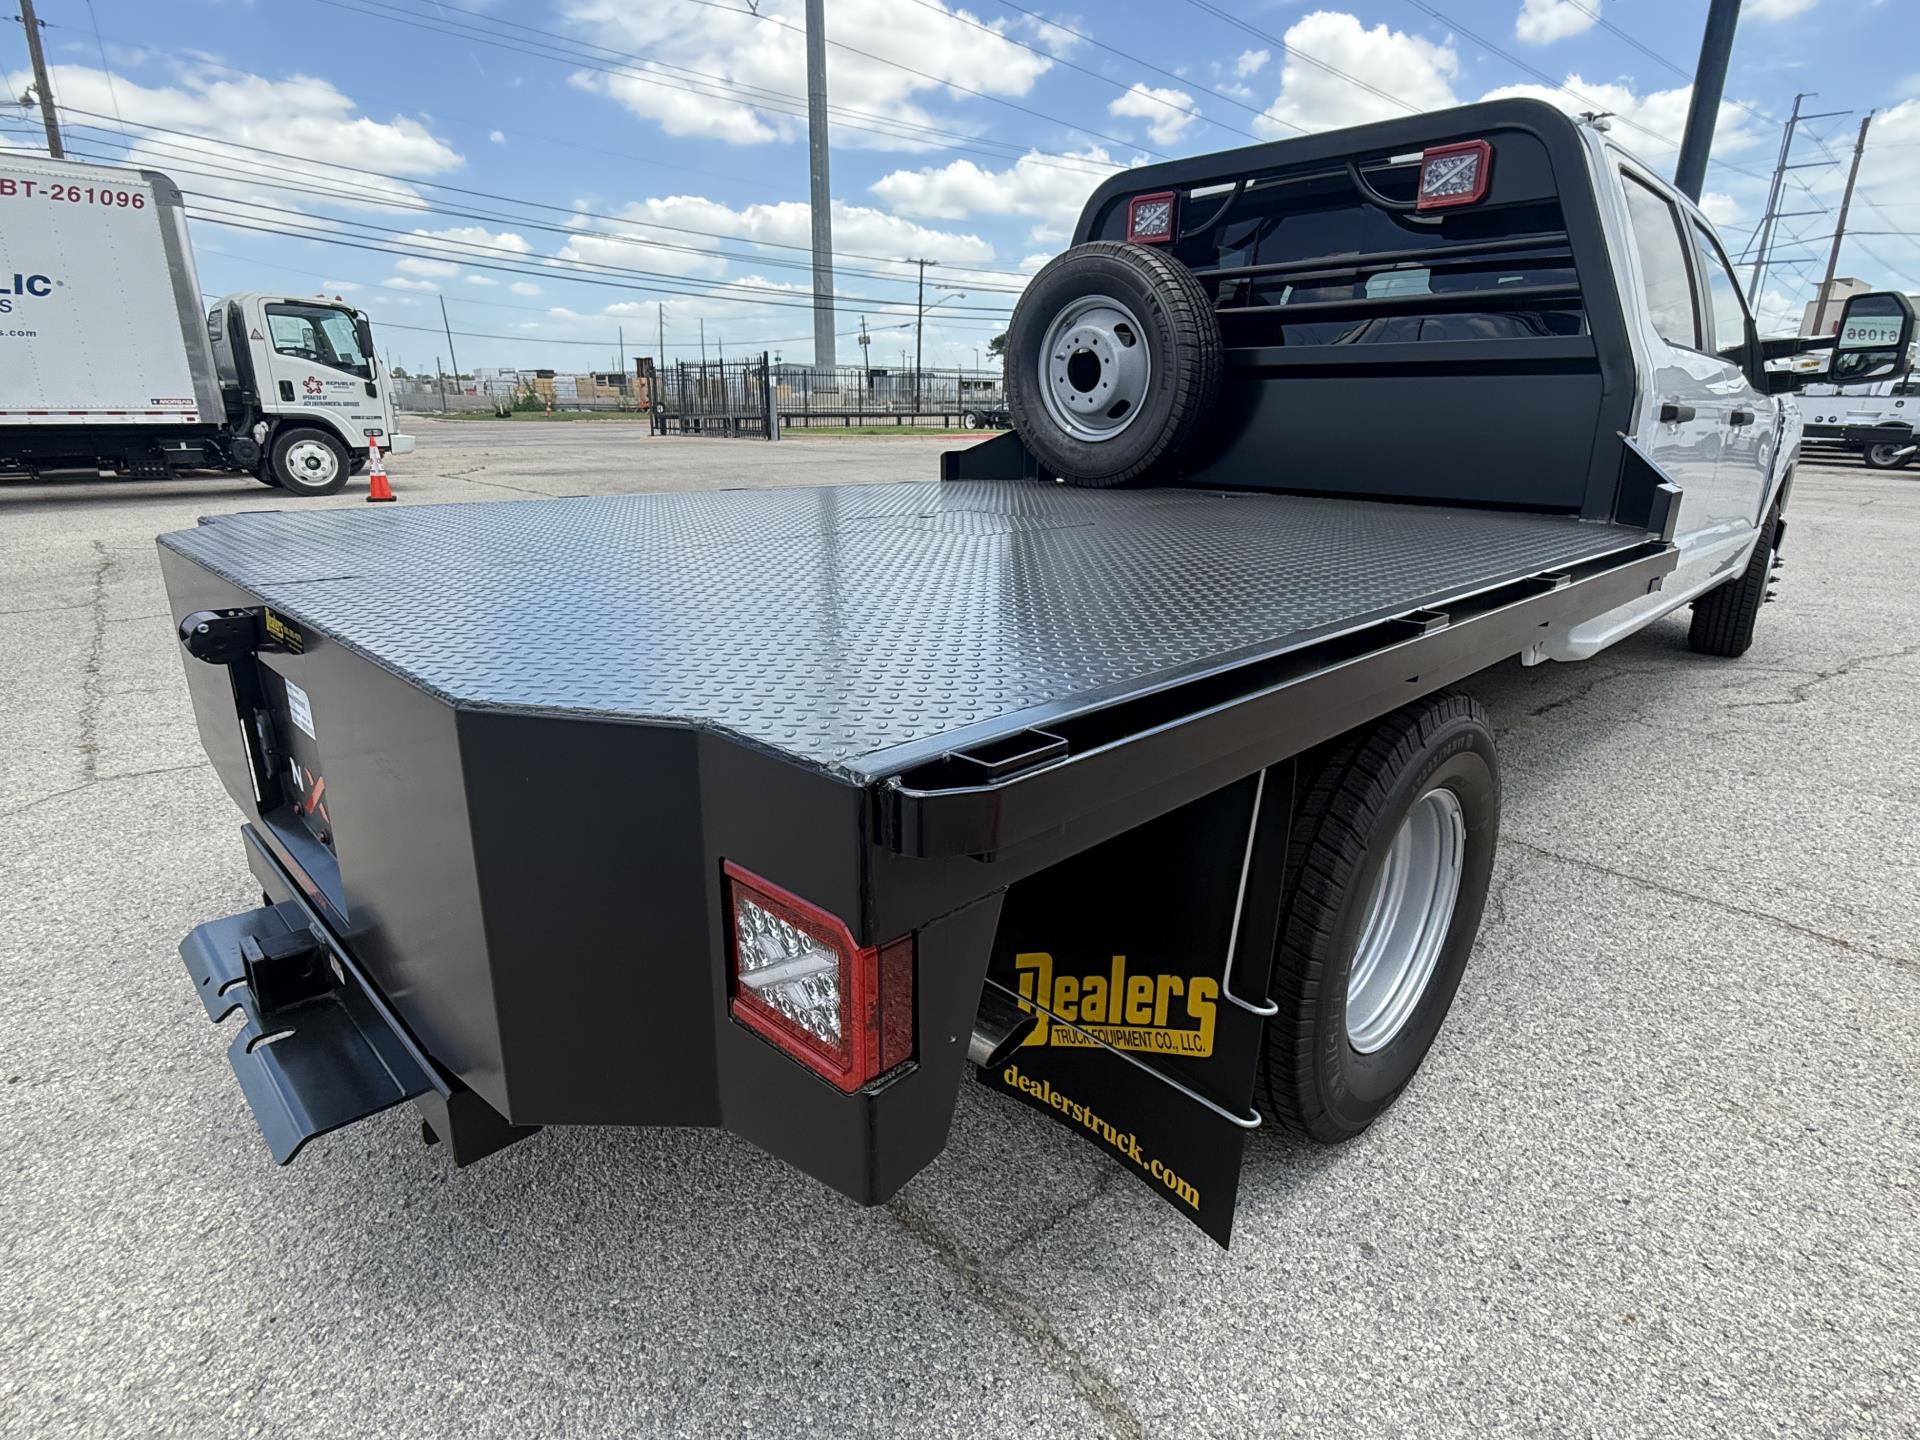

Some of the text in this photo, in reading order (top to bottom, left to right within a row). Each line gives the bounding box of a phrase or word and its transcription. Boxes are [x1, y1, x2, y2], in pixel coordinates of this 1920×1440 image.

[0, 178, 145, 209] BT-261096
[1015, 952, 1219, 1057] Dealers
[1054, 1028, 1091, 1045] TRUCK
[1093, 1030, 1152, 1049] EQUIPMENT
[1004, 1065, 1200, 1210] dealerstruck.com
